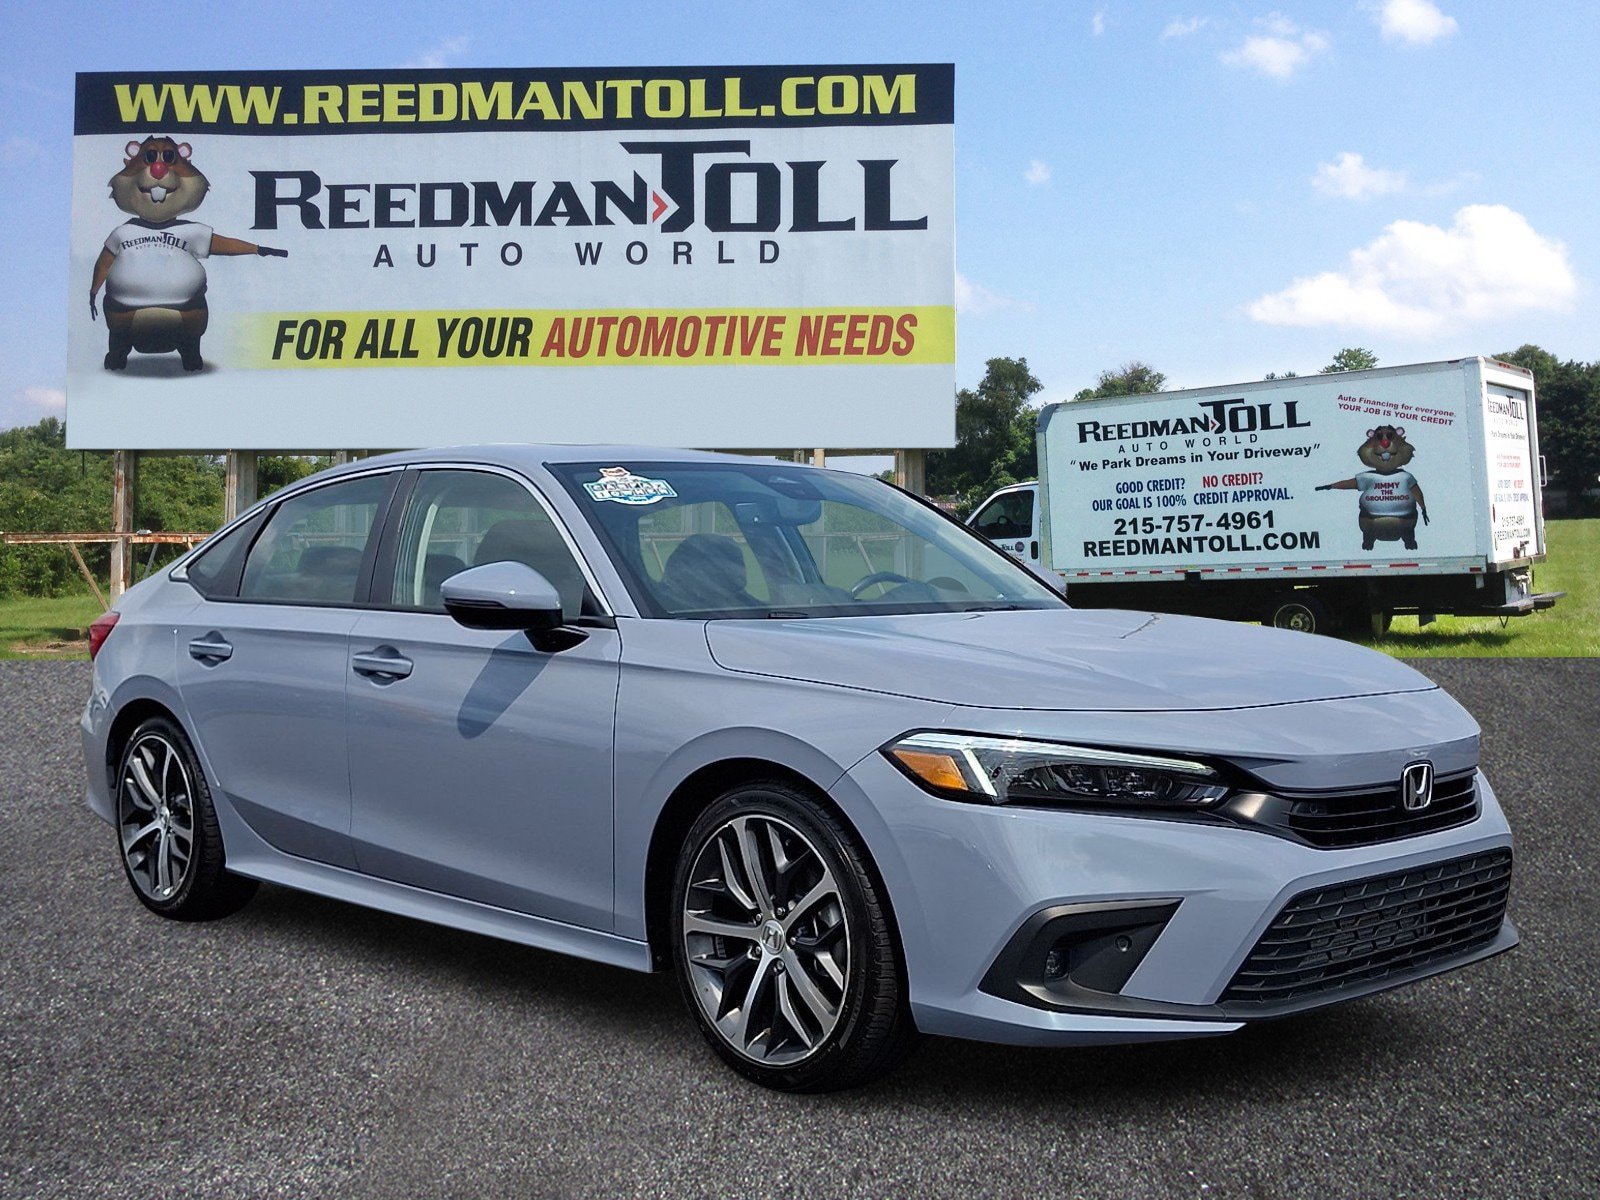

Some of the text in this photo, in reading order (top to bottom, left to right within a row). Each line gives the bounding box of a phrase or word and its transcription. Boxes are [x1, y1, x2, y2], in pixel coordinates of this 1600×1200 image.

[114, 74, 916, 125] WWW.REEDMANTOLL.COM
[373, 239, 781, 268] AUTO WORLD
[272, 313, 918, 360] FOR ALL YOUR AUTOMOTIVE NEEDS
[1337, 394, 1457, 418] Auto Financing for everyone.
[1338, 403, 1454, 426] YOUR JOB IS YOUR CREDIT
[1118, 434, 1258, 454] AUTO WORLD
[1102, 457, 1131, 470] Park
[1136, 453, 1187, 467] Dreams
[1190, 452, 1203, 463] in
[1207, 449, 1240, 462] Your
[1116, 472, 1264, 494] GOOD CREDIT? NO CREDIT?
[1374, 481, 1400, 490] JIMMY
[1092, 487, 1294, 512] OUR GOAL IS 100% CREDIT APPROVAL.
[1365, 494, 1410, 502] GROUNDHOG
[1114, 510, 1275, 536] 215-757-4961
[1083, 531, 1321, 558] REEDMANTOLL.COM
